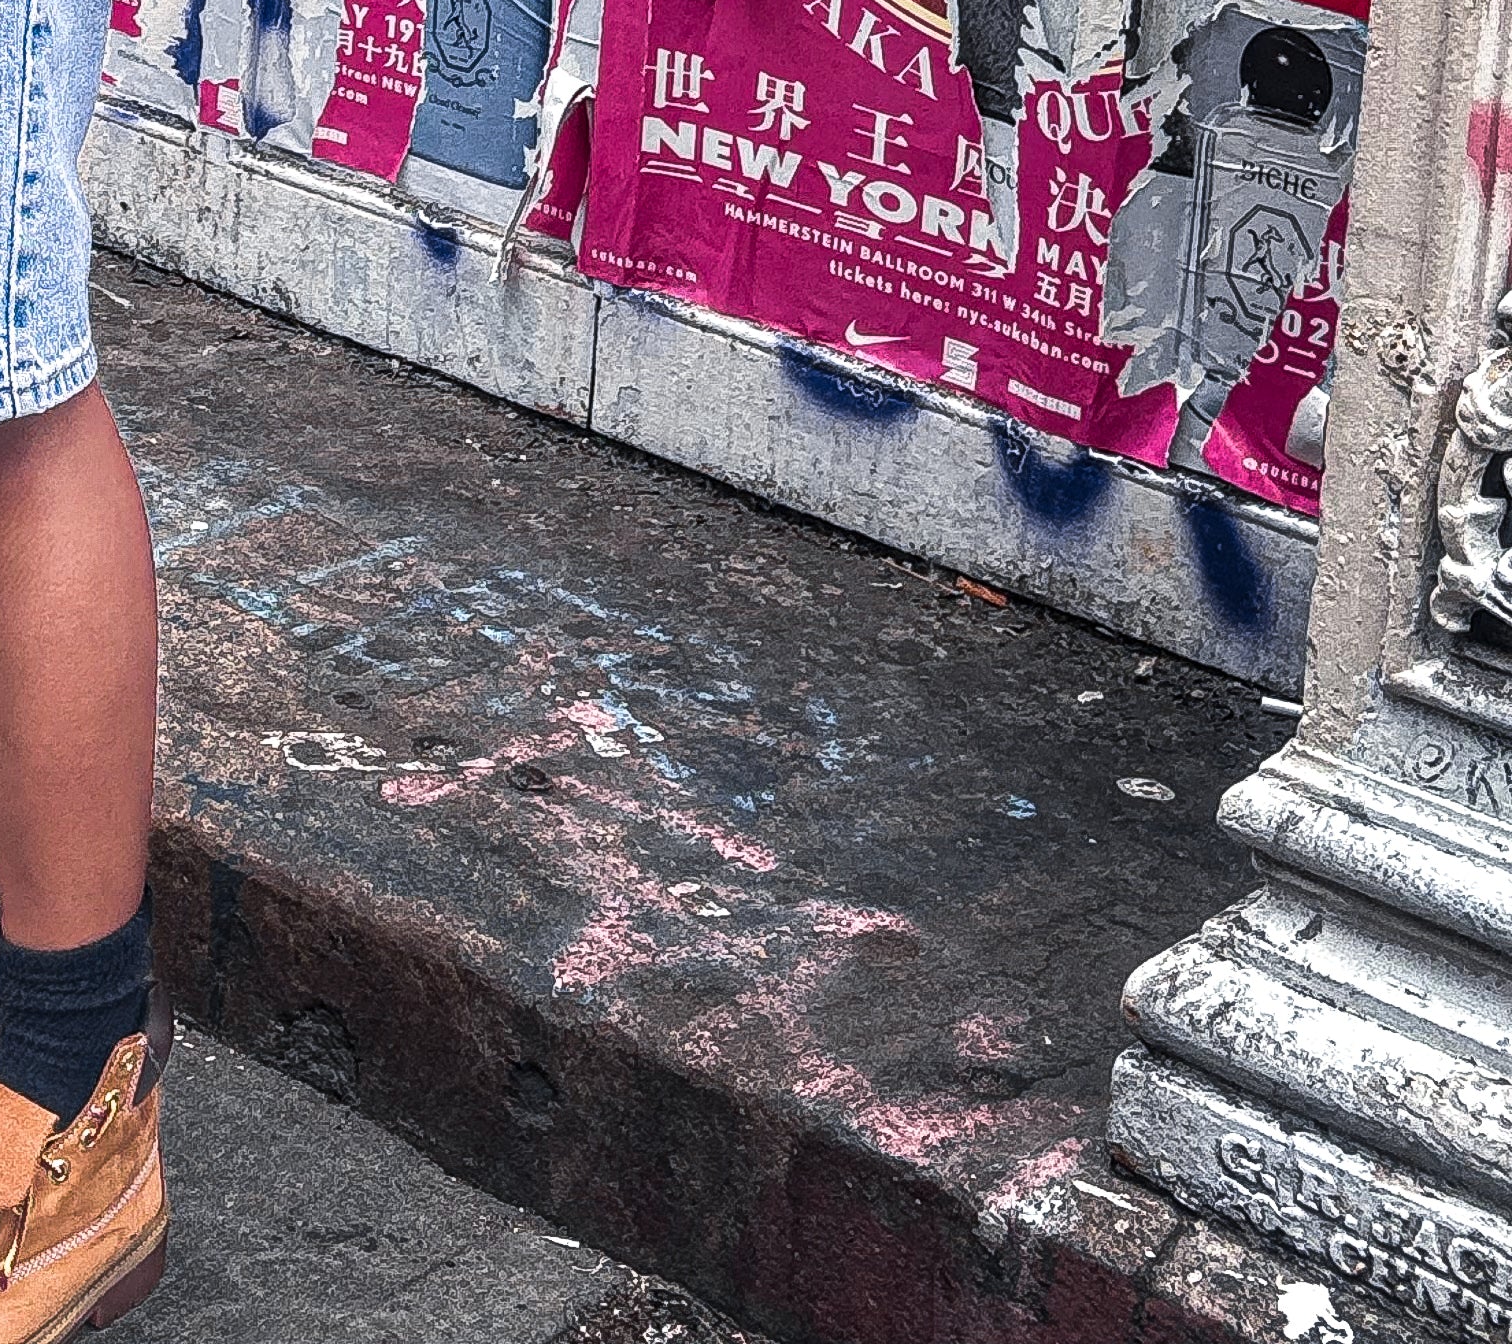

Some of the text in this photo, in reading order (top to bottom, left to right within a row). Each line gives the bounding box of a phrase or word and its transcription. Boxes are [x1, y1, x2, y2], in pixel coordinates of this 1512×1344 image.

[381, 76, 418, 98] NEW
[640, 115, 1016, 263] NEW YORK
[591, 248, 698, 284] sukeban.com
[724, 201, 854, 257] HAMMERSTEIN
[858, 245, 965, 292] BALLROOM
[970, 281, 998, 306] 311
[1002, 291, 1017, 310] W
[1020, 301, 1057, 332] 34th
[1036, 237, 1107, 287] MAY
[829, 258, 1111, 375] tickets here: nyc.sukeban.com
